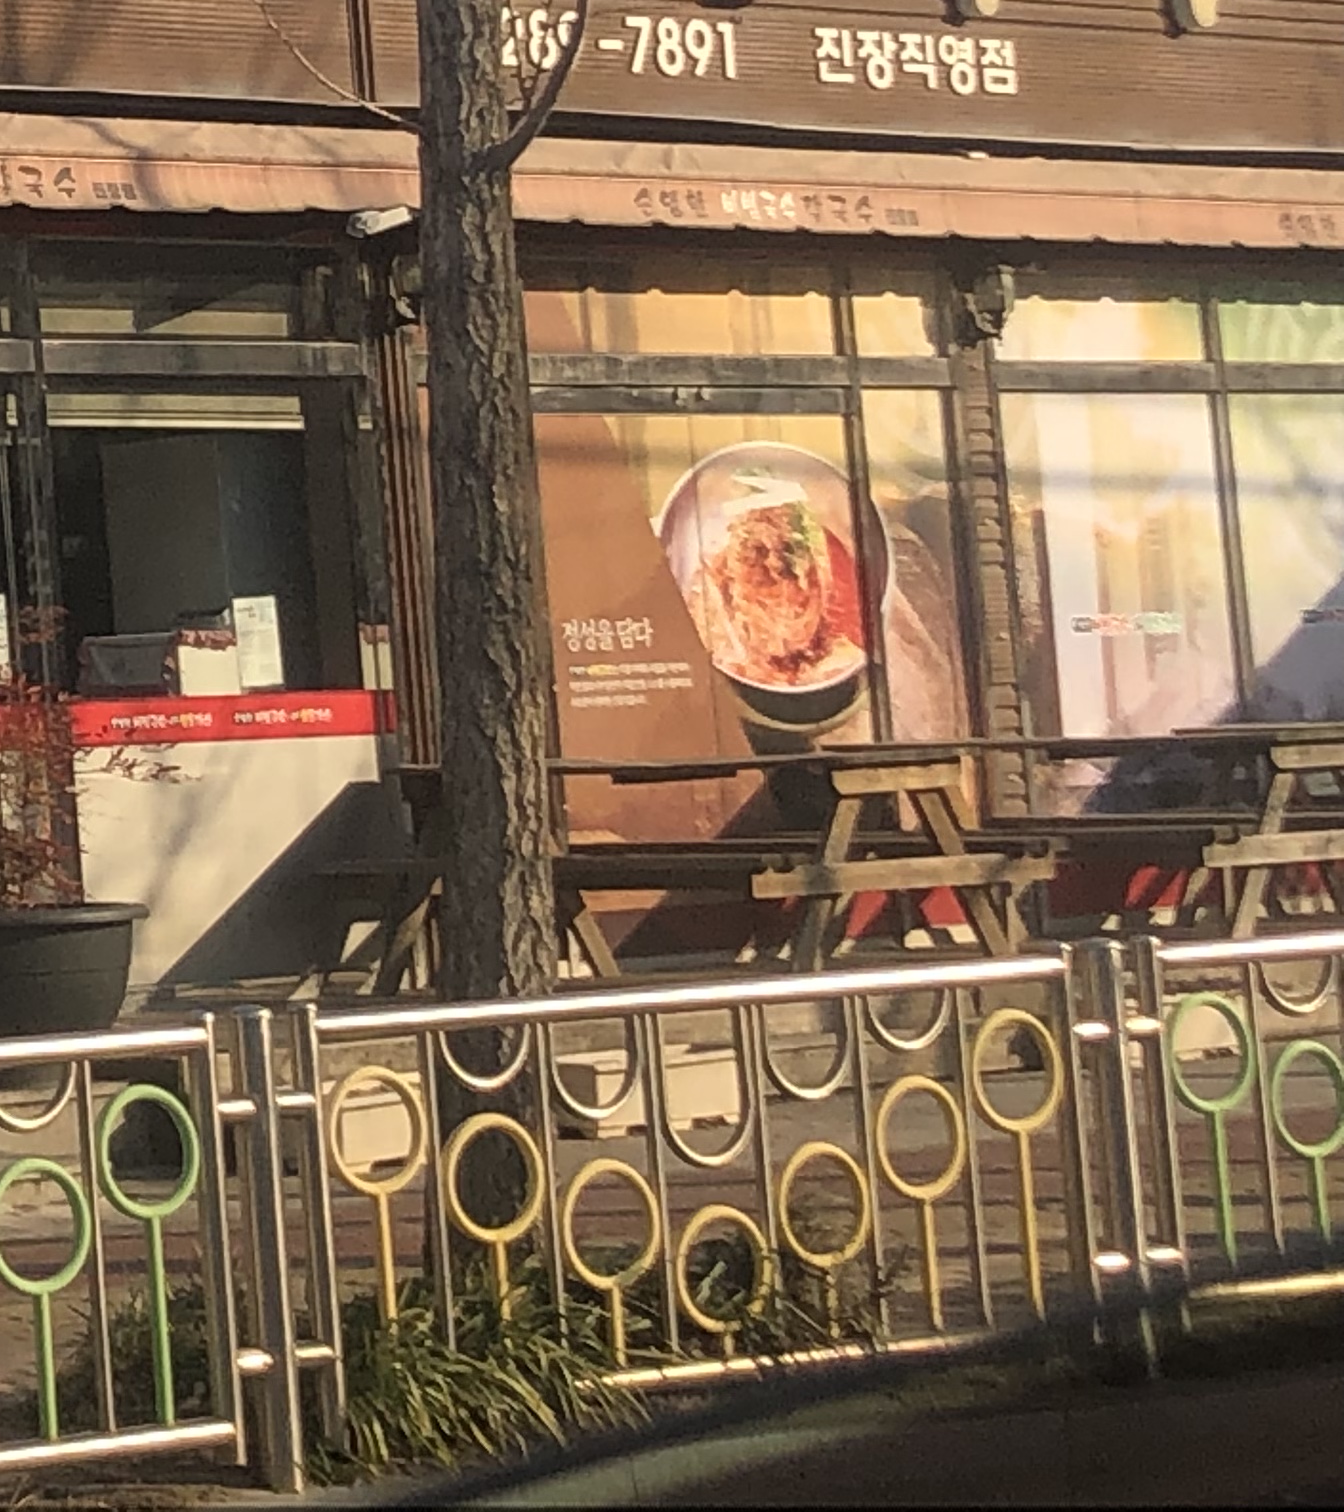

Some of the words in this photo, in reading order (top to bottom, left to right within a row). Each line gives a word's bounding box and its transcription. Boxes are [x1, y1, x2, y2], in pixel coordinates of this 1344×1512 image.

[813, 27, 1018, 95] 진장직영점
[561, 618, 615, 652] 정성을
[615, 617, 655, 649] 담다
